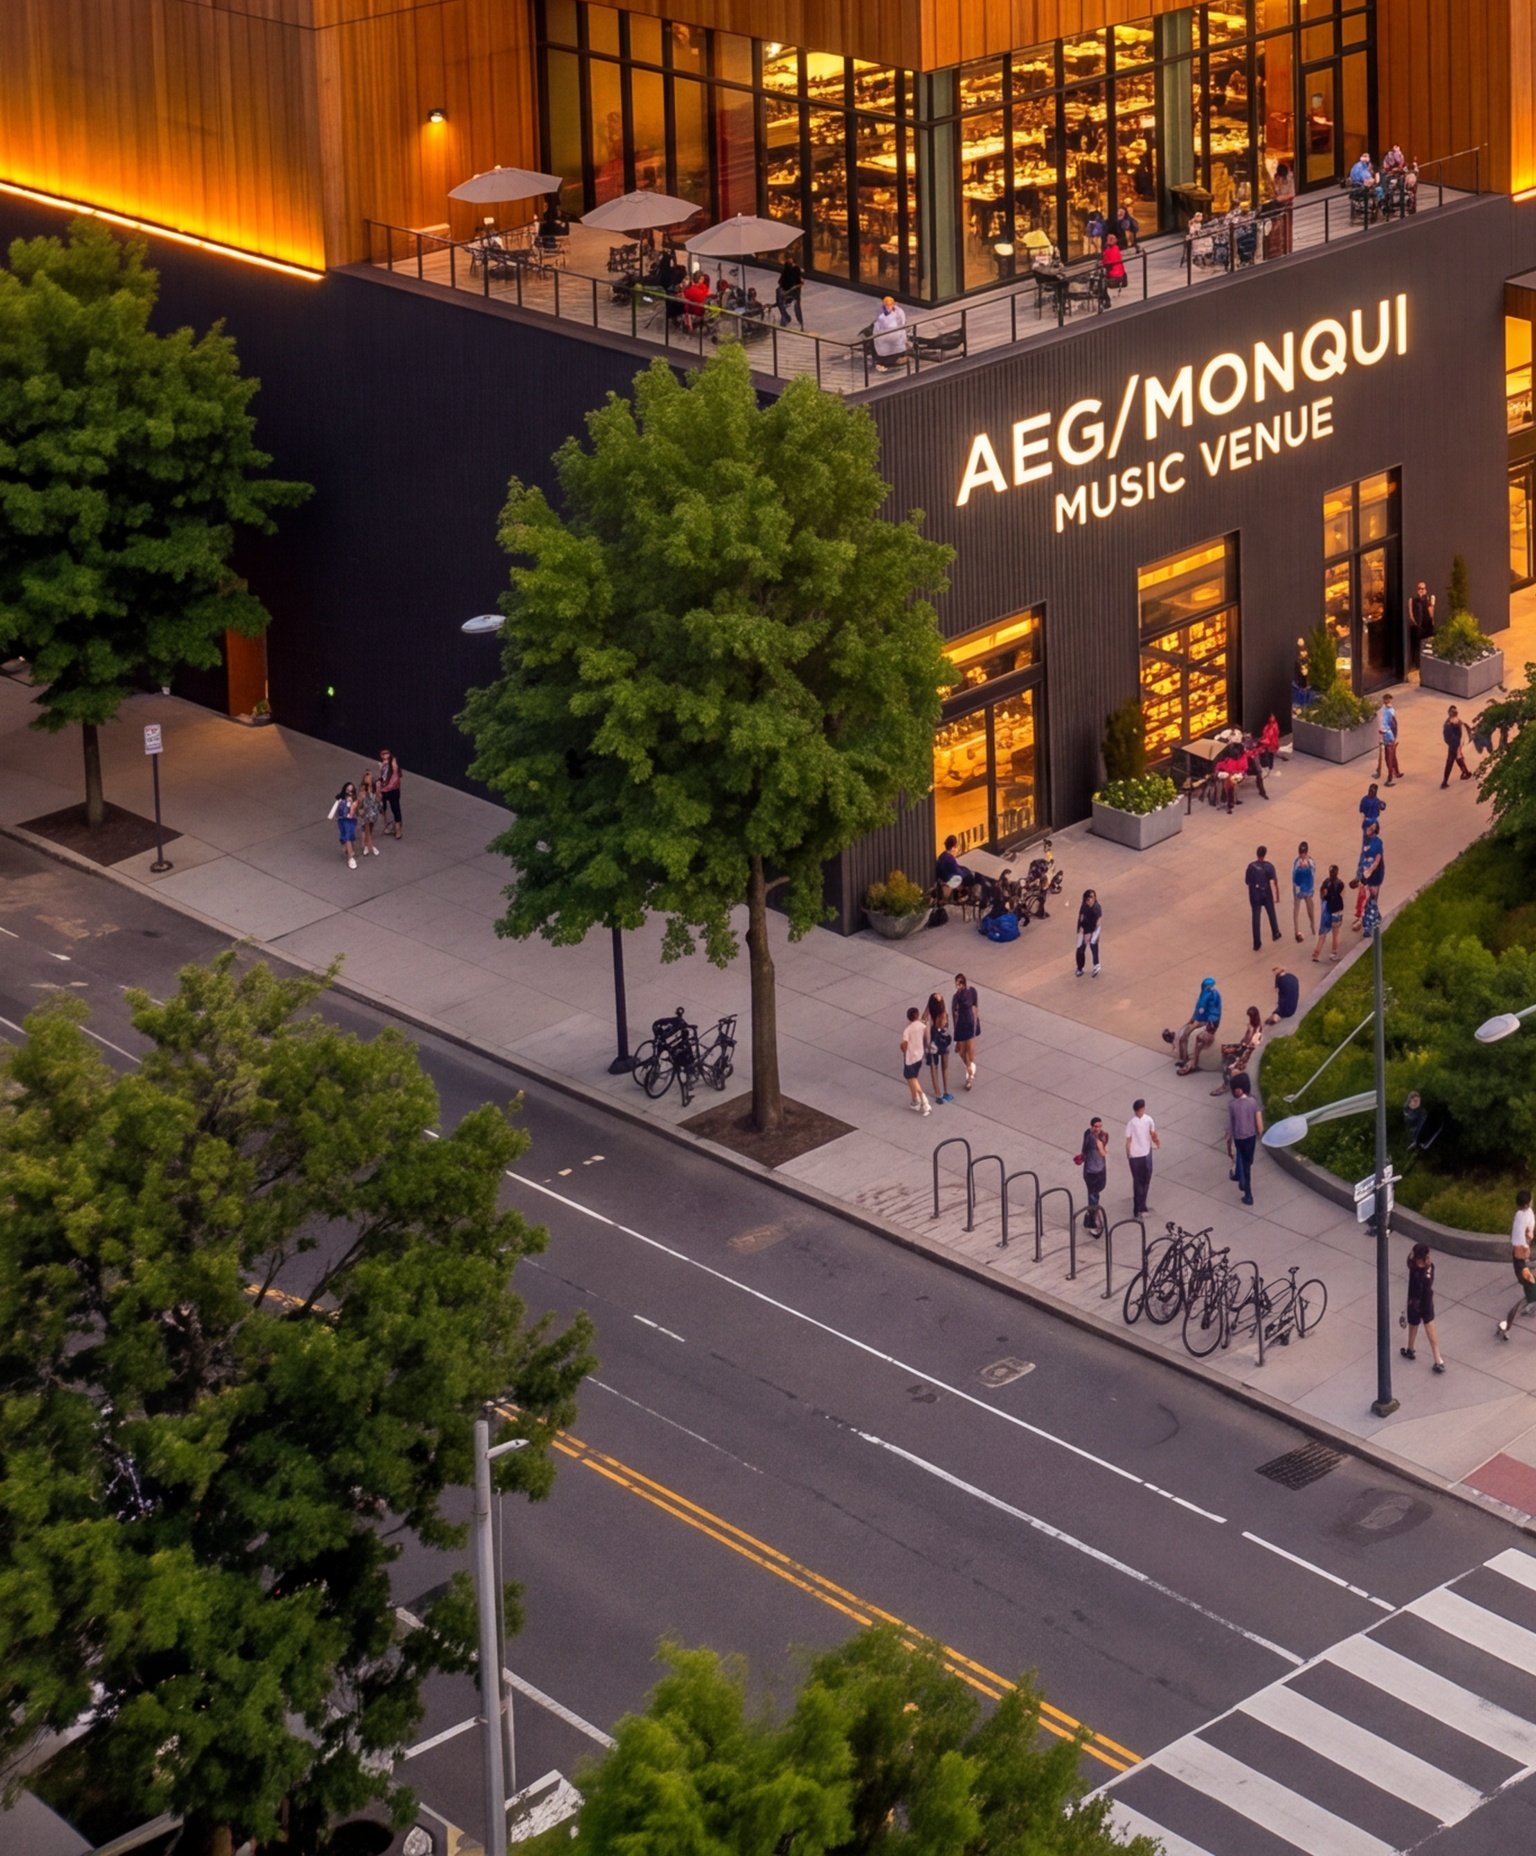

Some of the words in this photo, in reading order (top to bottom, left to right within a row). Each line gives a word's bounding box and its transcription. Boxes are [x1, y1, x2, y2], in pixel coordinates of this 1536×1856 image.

[956, 293, 1408, 507] AEG/MONQUI
[1055, 452, 1186, 533] MUSIC
[1200, 396, 1334, 477] VENUE
